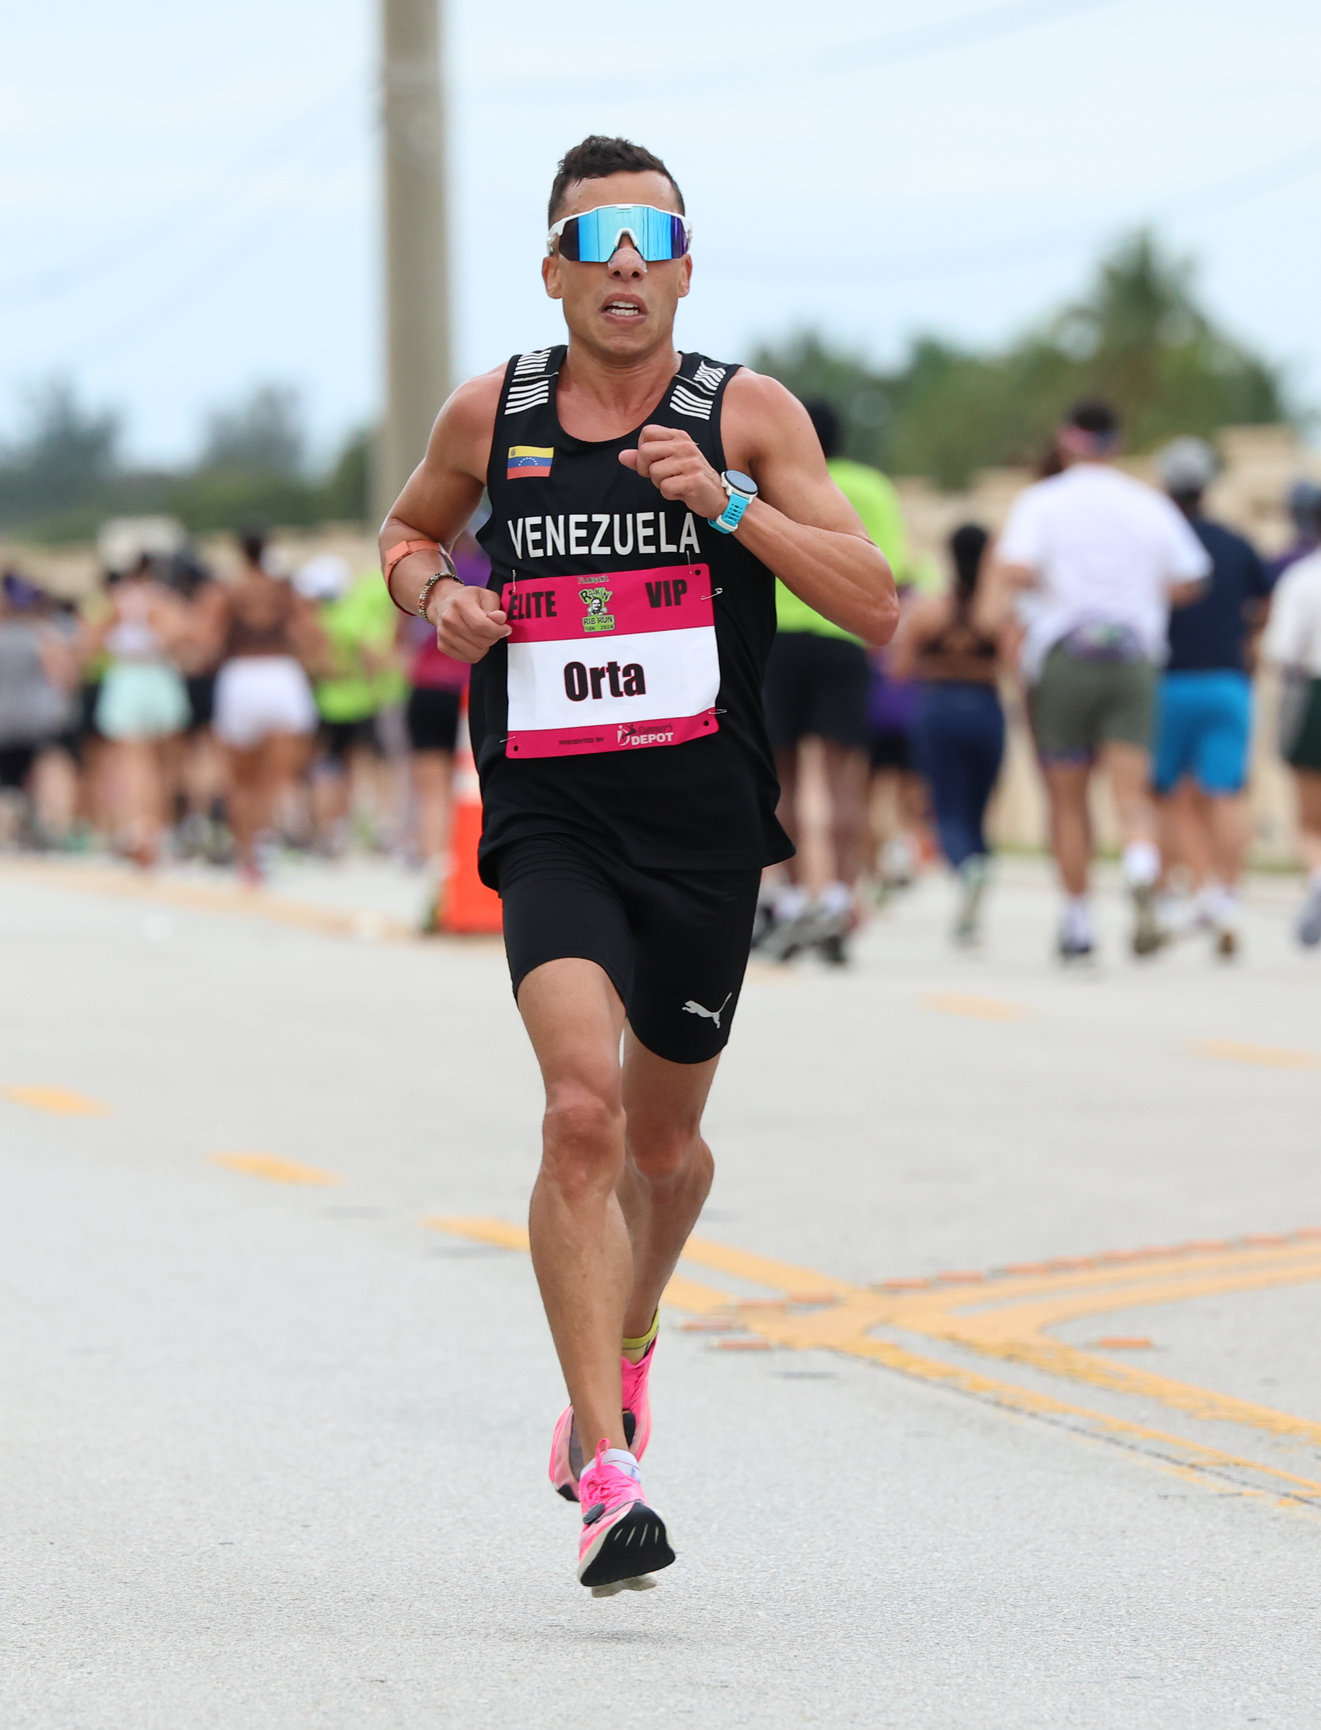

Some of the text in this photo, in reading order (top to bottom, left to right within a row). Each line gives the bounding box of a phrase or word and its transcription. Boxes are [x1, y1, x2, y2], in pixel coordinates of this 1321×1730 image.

[507, 511, 701, 560] VENEZUELA
[507, 590, 557, 620] ELITE
[645, 579, 688, 608] VIP
[597, 615, 613, 624] RUN
[563, 660, 647, 702] Orta
[631, 732, 674, 746] DEPOT
